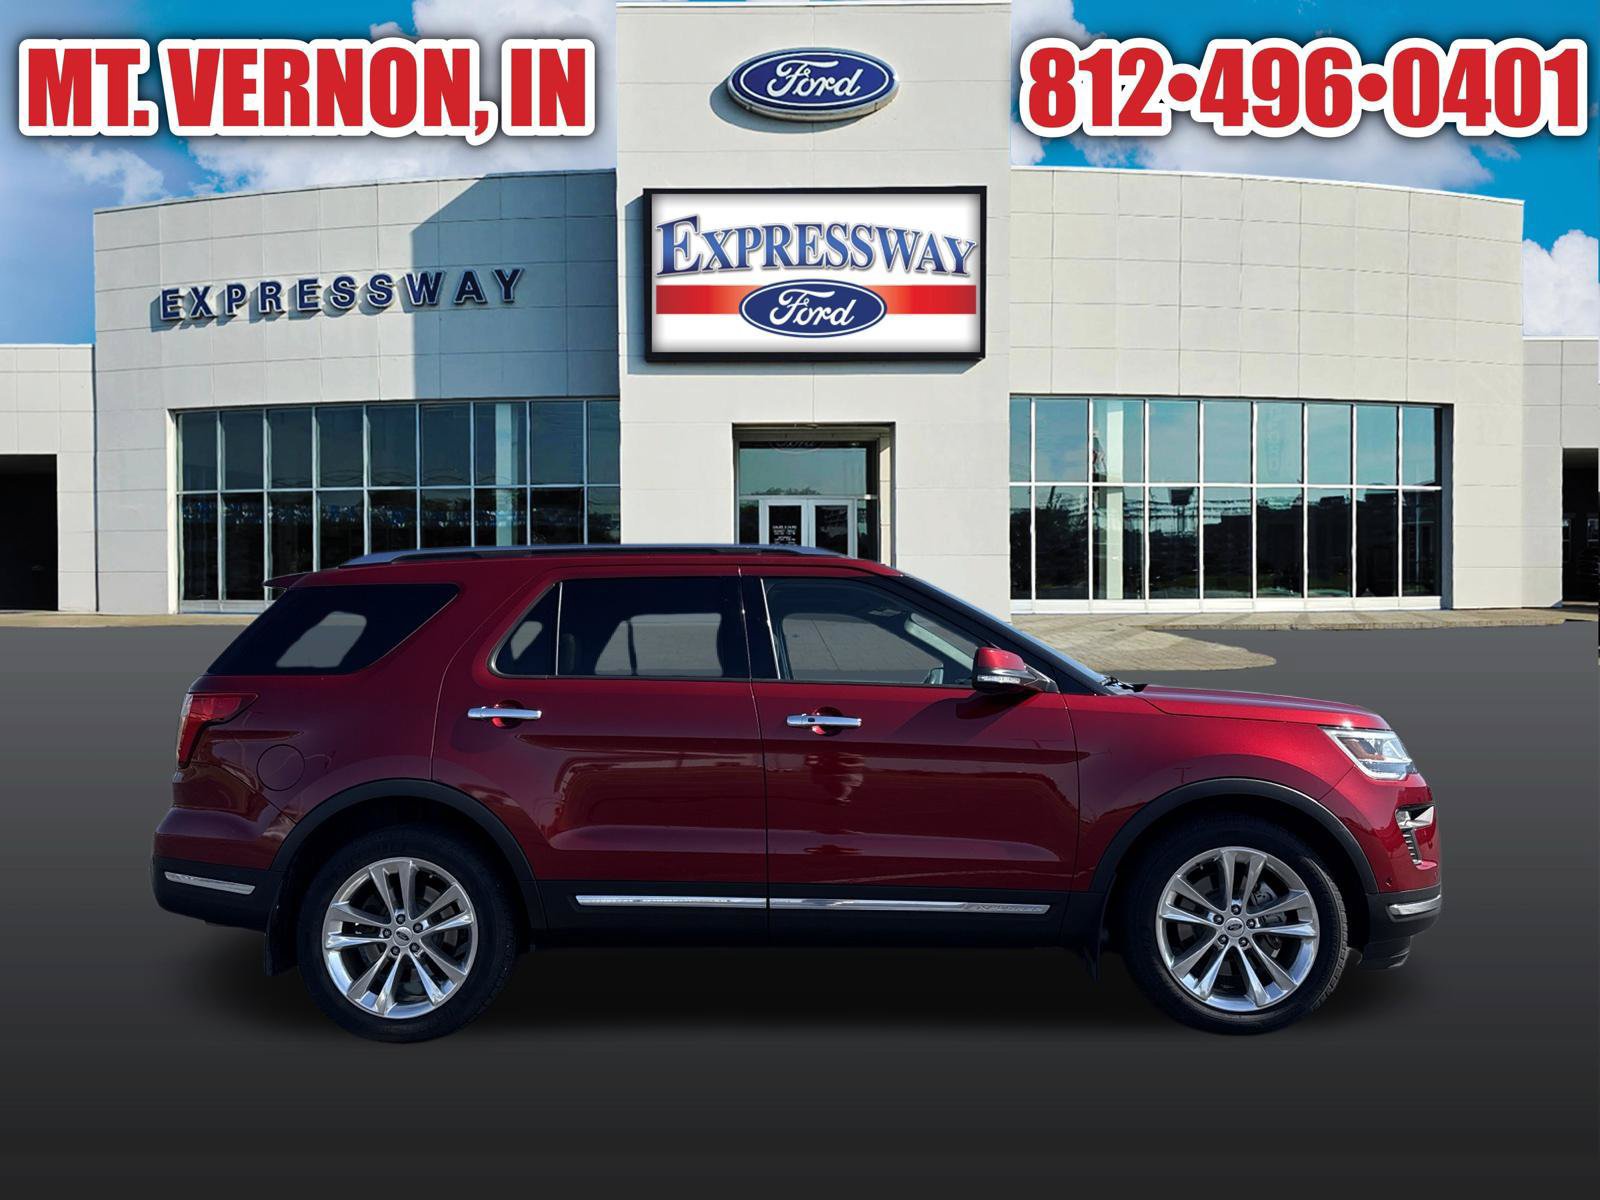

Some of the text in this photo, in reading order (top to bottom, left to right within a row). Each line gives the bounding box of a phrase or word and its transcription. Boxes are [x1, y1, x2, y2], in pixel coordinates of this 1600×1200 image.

[766, 59, 864, 97] Ford
[159, 267, 525, 322] EXPRESSWAY
[769, 288, 857, 326] Ford
